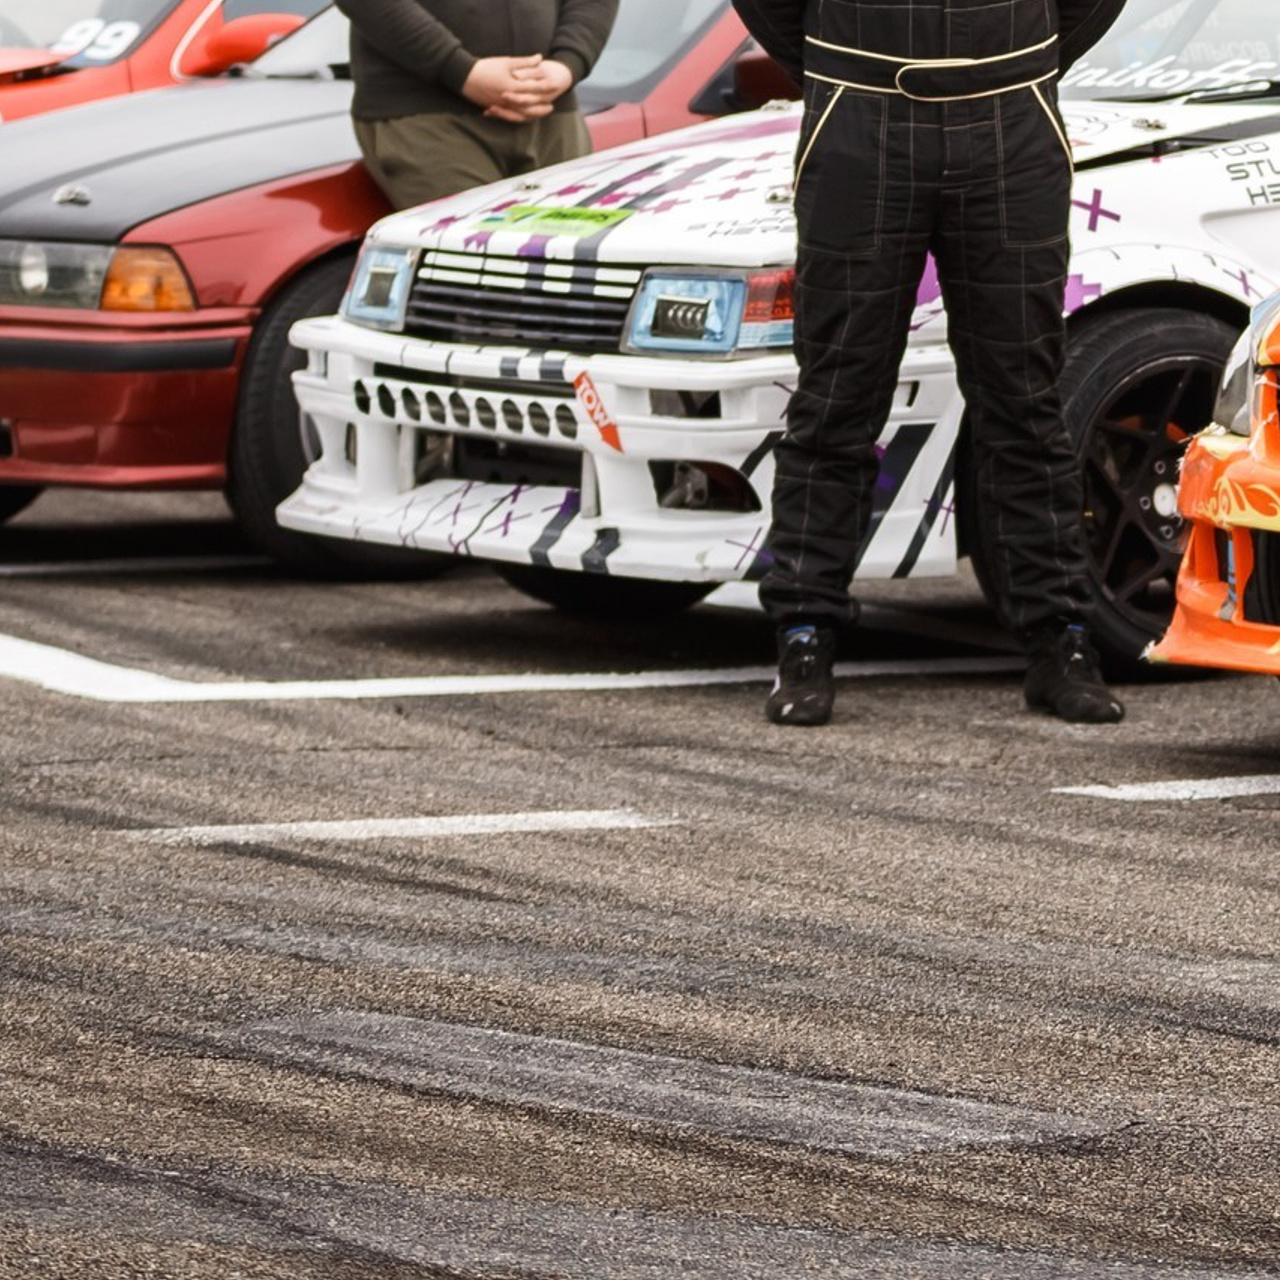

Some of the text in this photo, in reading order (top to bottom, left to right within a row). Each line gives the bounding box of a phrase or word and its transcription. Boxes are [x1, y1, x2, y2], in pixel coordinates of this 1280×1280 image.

[50, 18, 141, 61] 99
[1200, 141, 1270, 159] TOO
[576, 378, 610, 427] TOW
